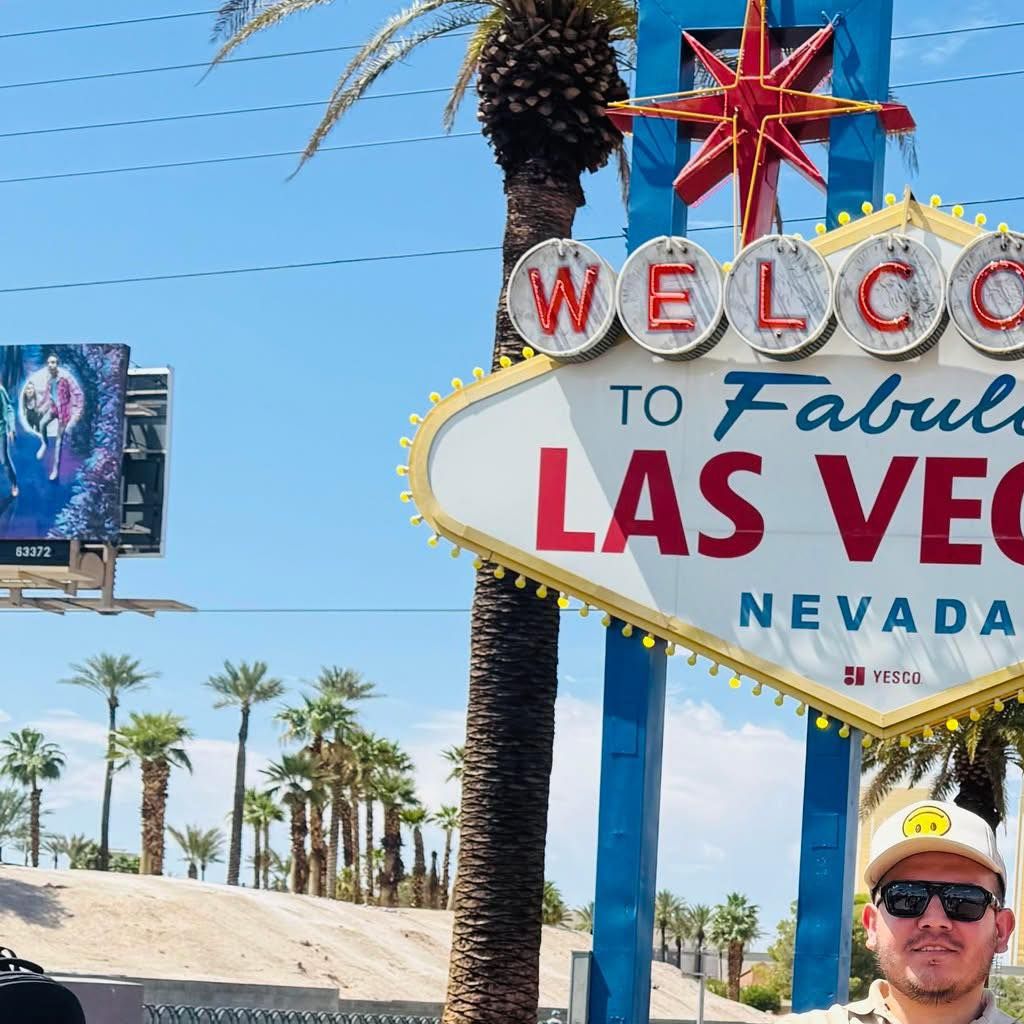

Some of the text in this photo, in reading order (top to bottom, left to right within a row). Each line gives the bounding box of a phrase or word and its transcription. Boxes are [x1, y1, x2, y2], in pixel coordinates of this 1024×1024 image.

[609, 384, 684, 426] TO
[535, 447, 765, 559] LAS
[15, 545, 52, 558] 63372
[738, 591, 1016, 636] NEVADA
[873, 669, 922, 685] YESCO
